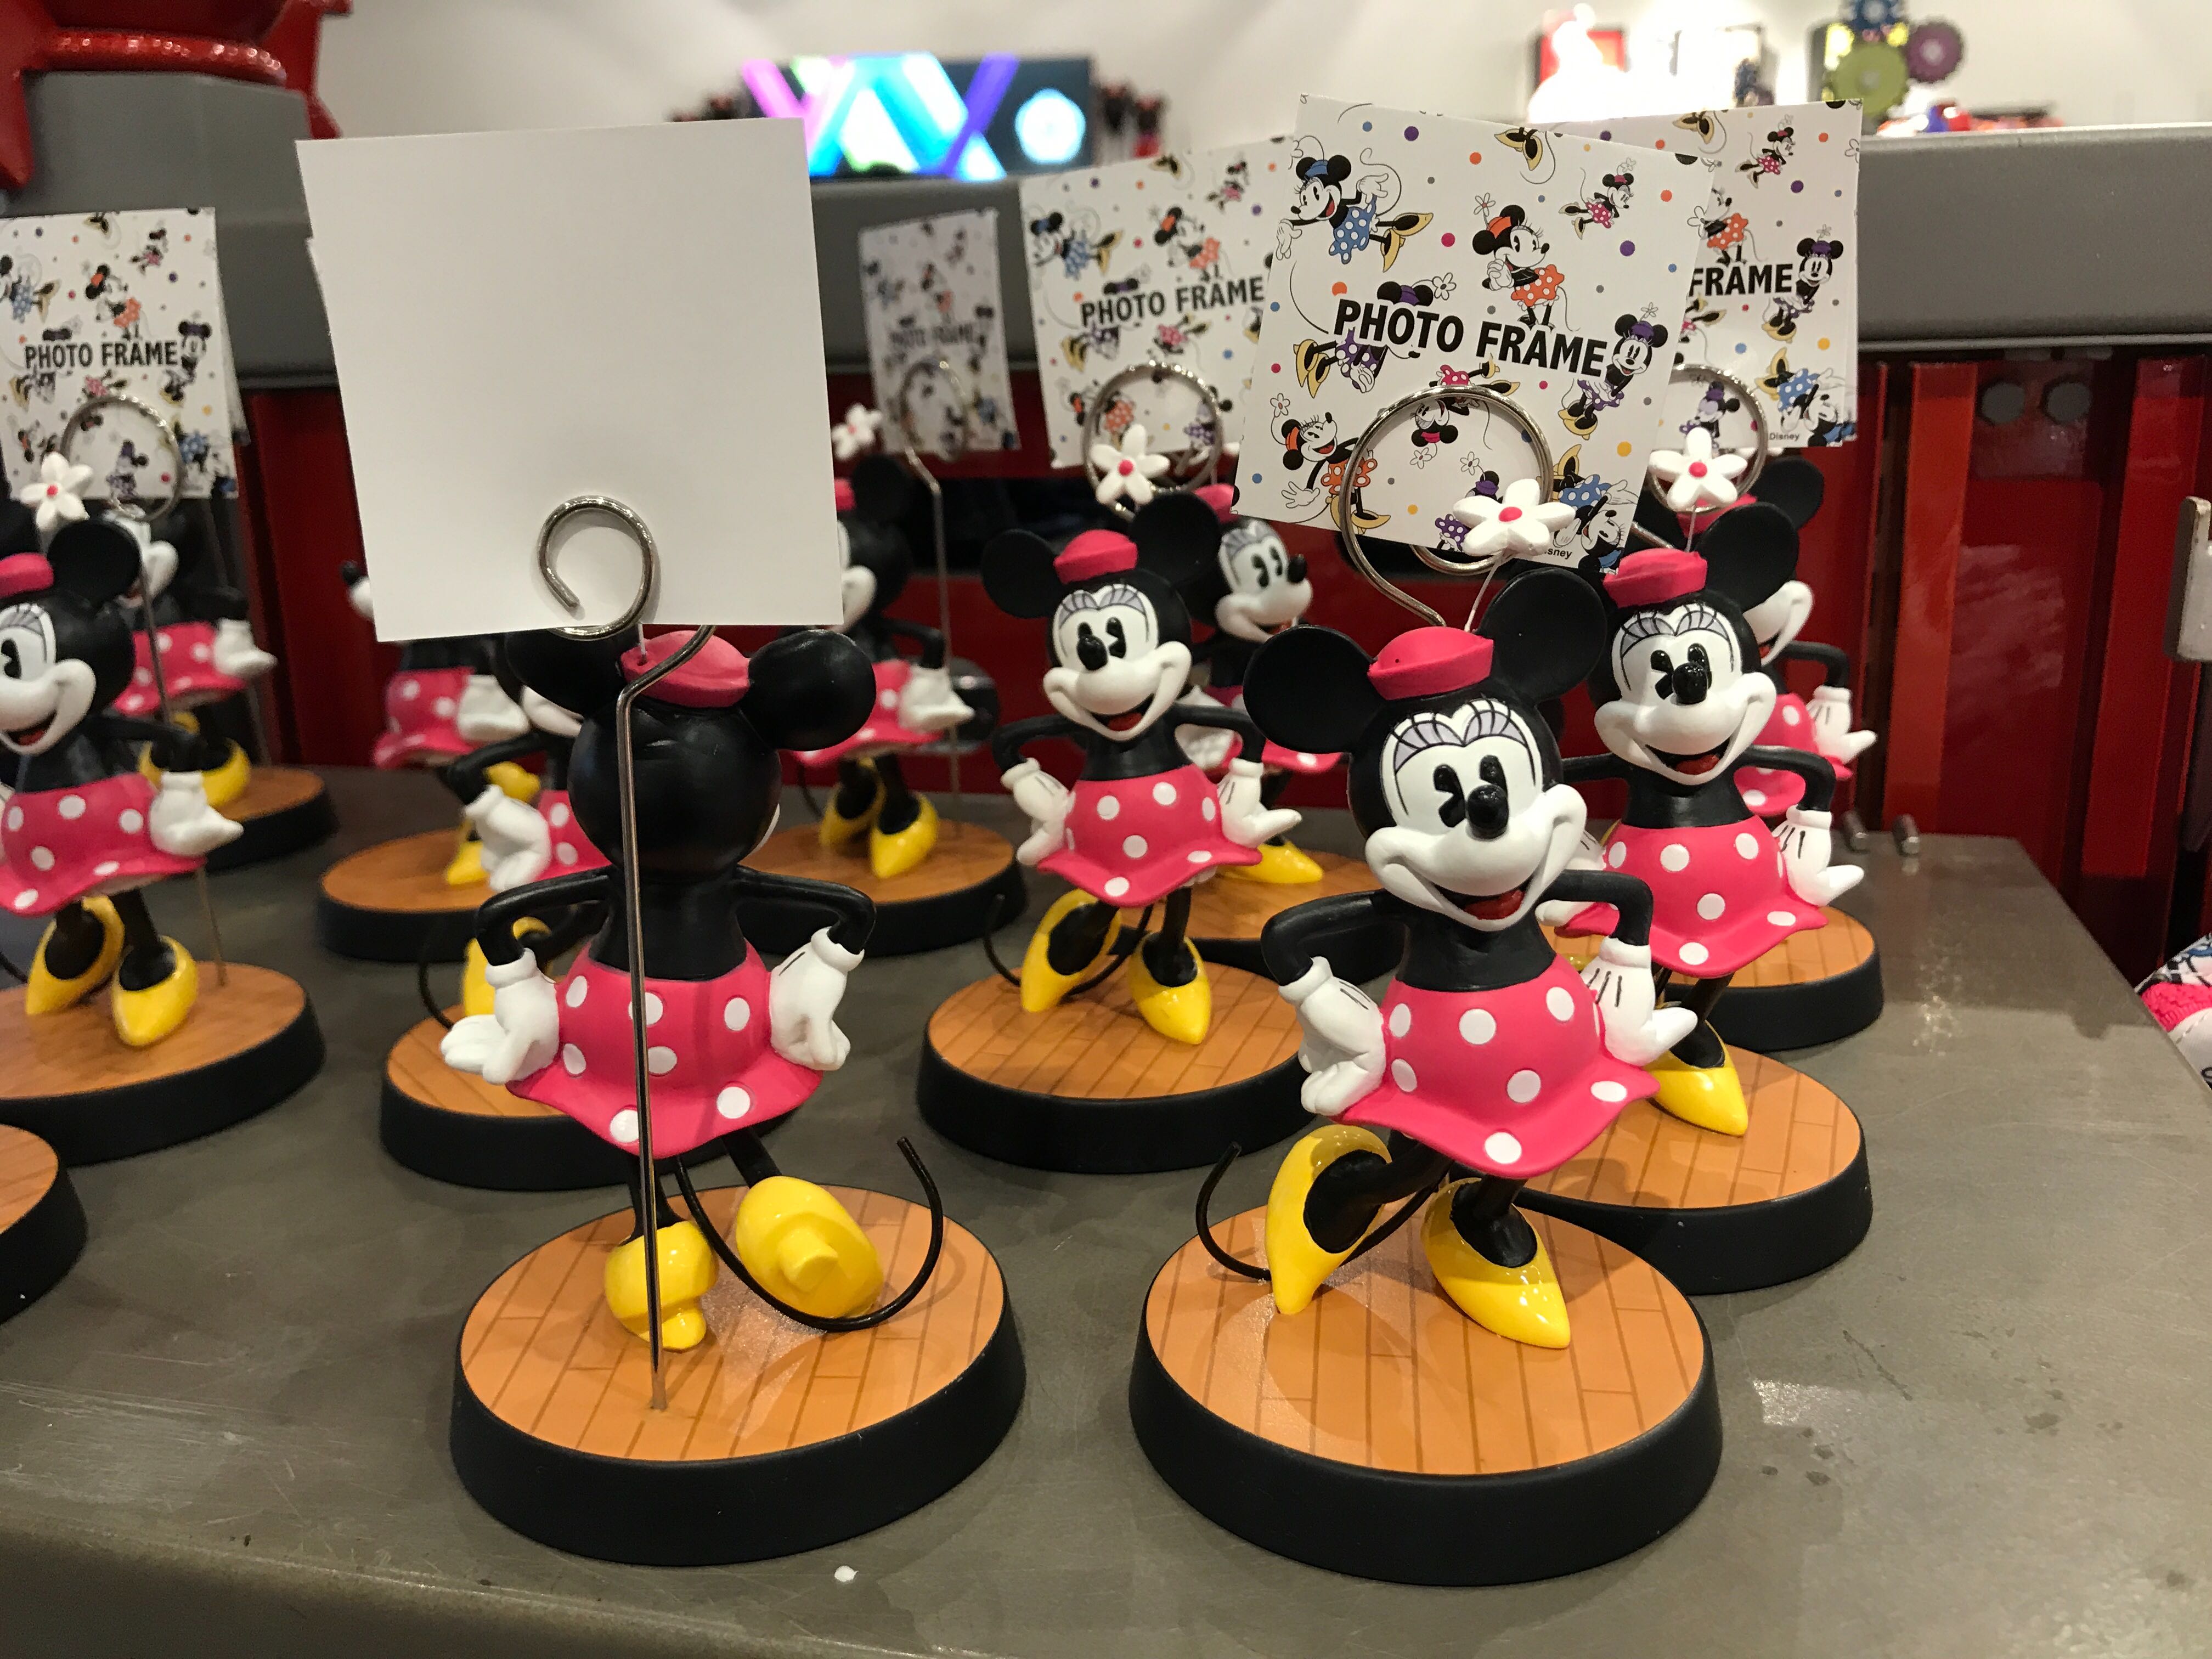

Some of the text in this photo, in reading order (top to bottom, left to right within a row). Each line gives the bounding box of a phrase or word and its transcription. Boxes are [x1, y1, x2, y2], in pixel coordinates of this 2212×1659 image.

[1689, 263, 1793, 297] FRAME
[1080, 276, 1265, 327] PHOTO FRAME
[1334, 299, 1608, 377] PHOTO FRAME
[25, 340, 177, 369] PHOTO FRAME
[1769, 432, 1800, 442] Disney
[1544, 548, 1572, 560] sney
